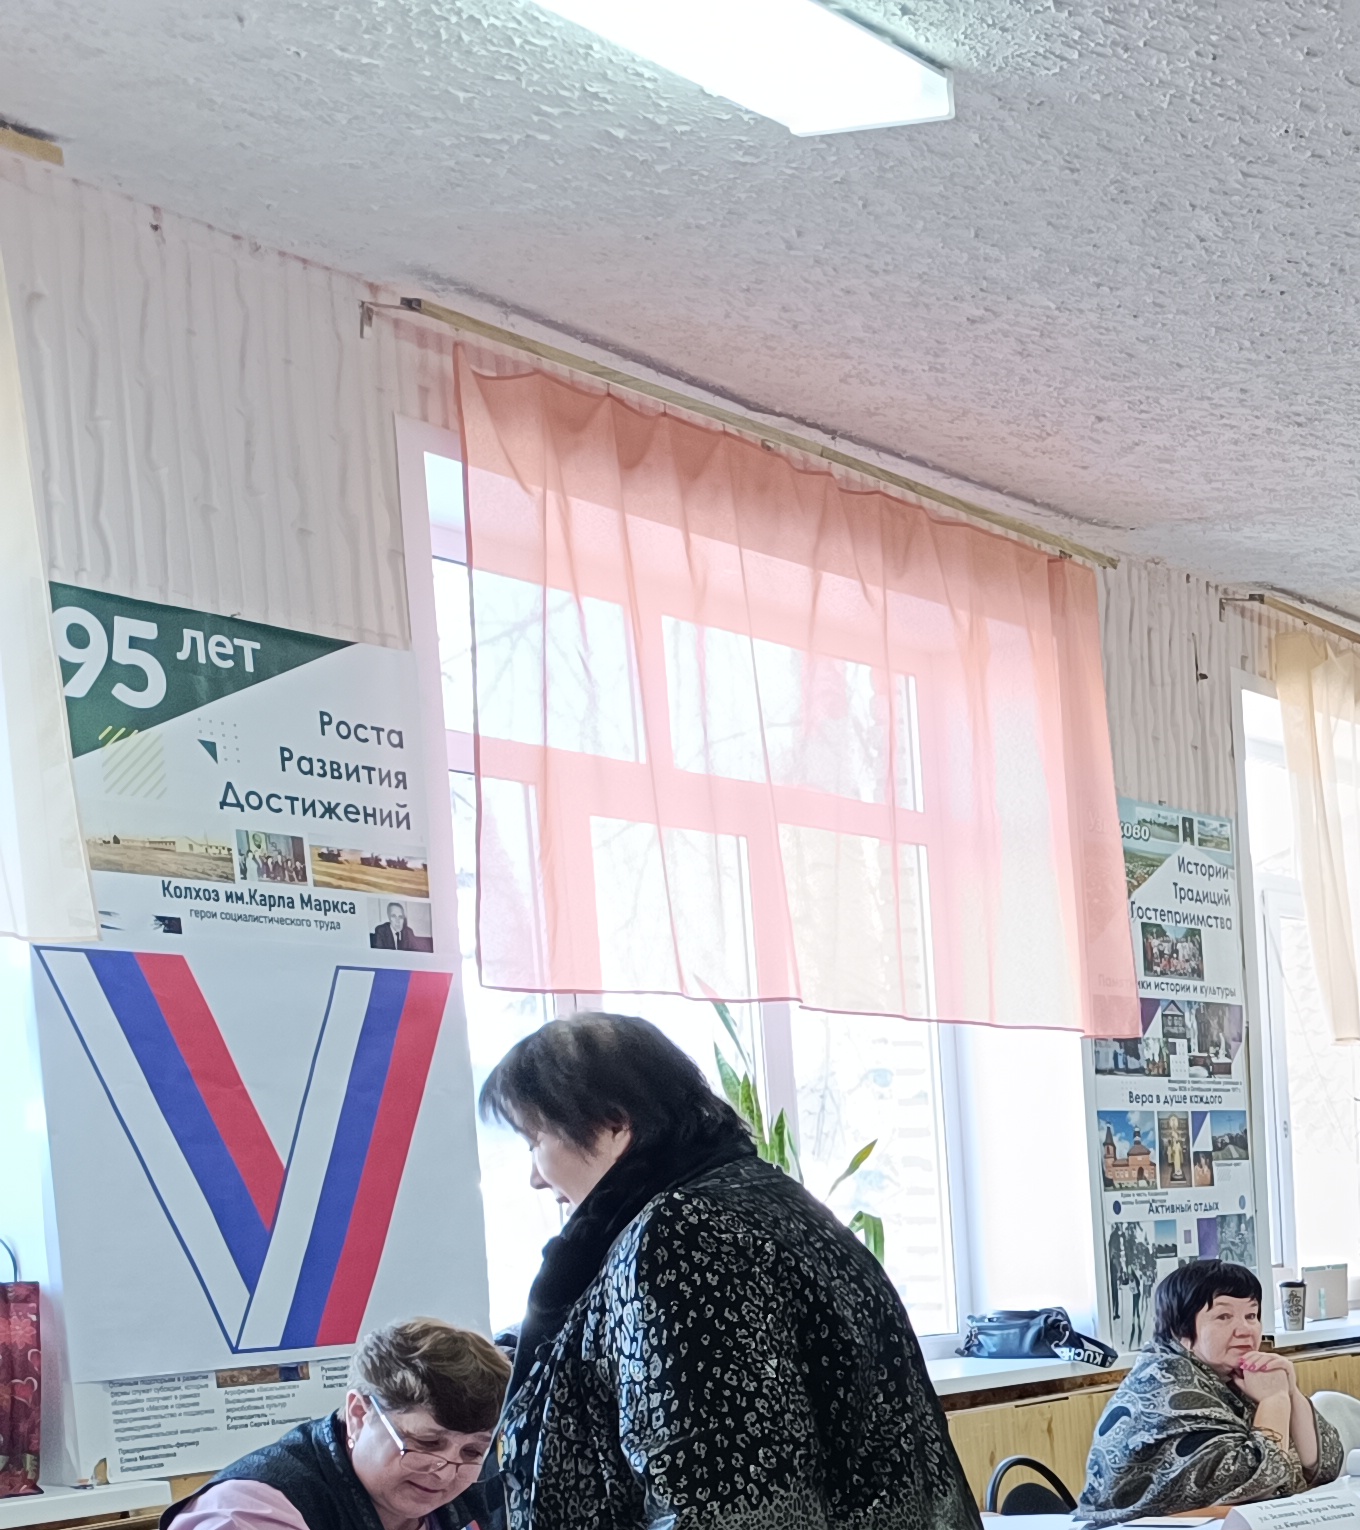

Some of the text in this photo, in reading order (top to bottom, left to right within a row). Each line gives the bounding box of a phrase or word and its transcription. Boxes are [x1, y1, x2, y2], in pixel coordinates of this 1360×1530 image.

[51, 606, 261, 709] 95 лет
[319, 710, 404, 749] Роста
[279, 746, 409, 791] Развития
[219, 781, 412, 831] Достижений
[1177, 856, 1229, 881] Истории
[161, 880, 220, 902] Колхоз
[300, 892, 357, 916] Маркса
[1172, 882, 1232, 907] Традиций
[189, 908, 342, 931] герои социалистического труда
[1130, 901, 1233, 930] Гостеприимства
[1153, 980, 1191, 995] истории
[1199, 985, 1237, 998] культуры
[1128, 1091, 1223, 1107] Вера в душе каждого
[1147, 1200, 1192, 1215] Активный
[1193, 1201, 1219, 1212] отдых
